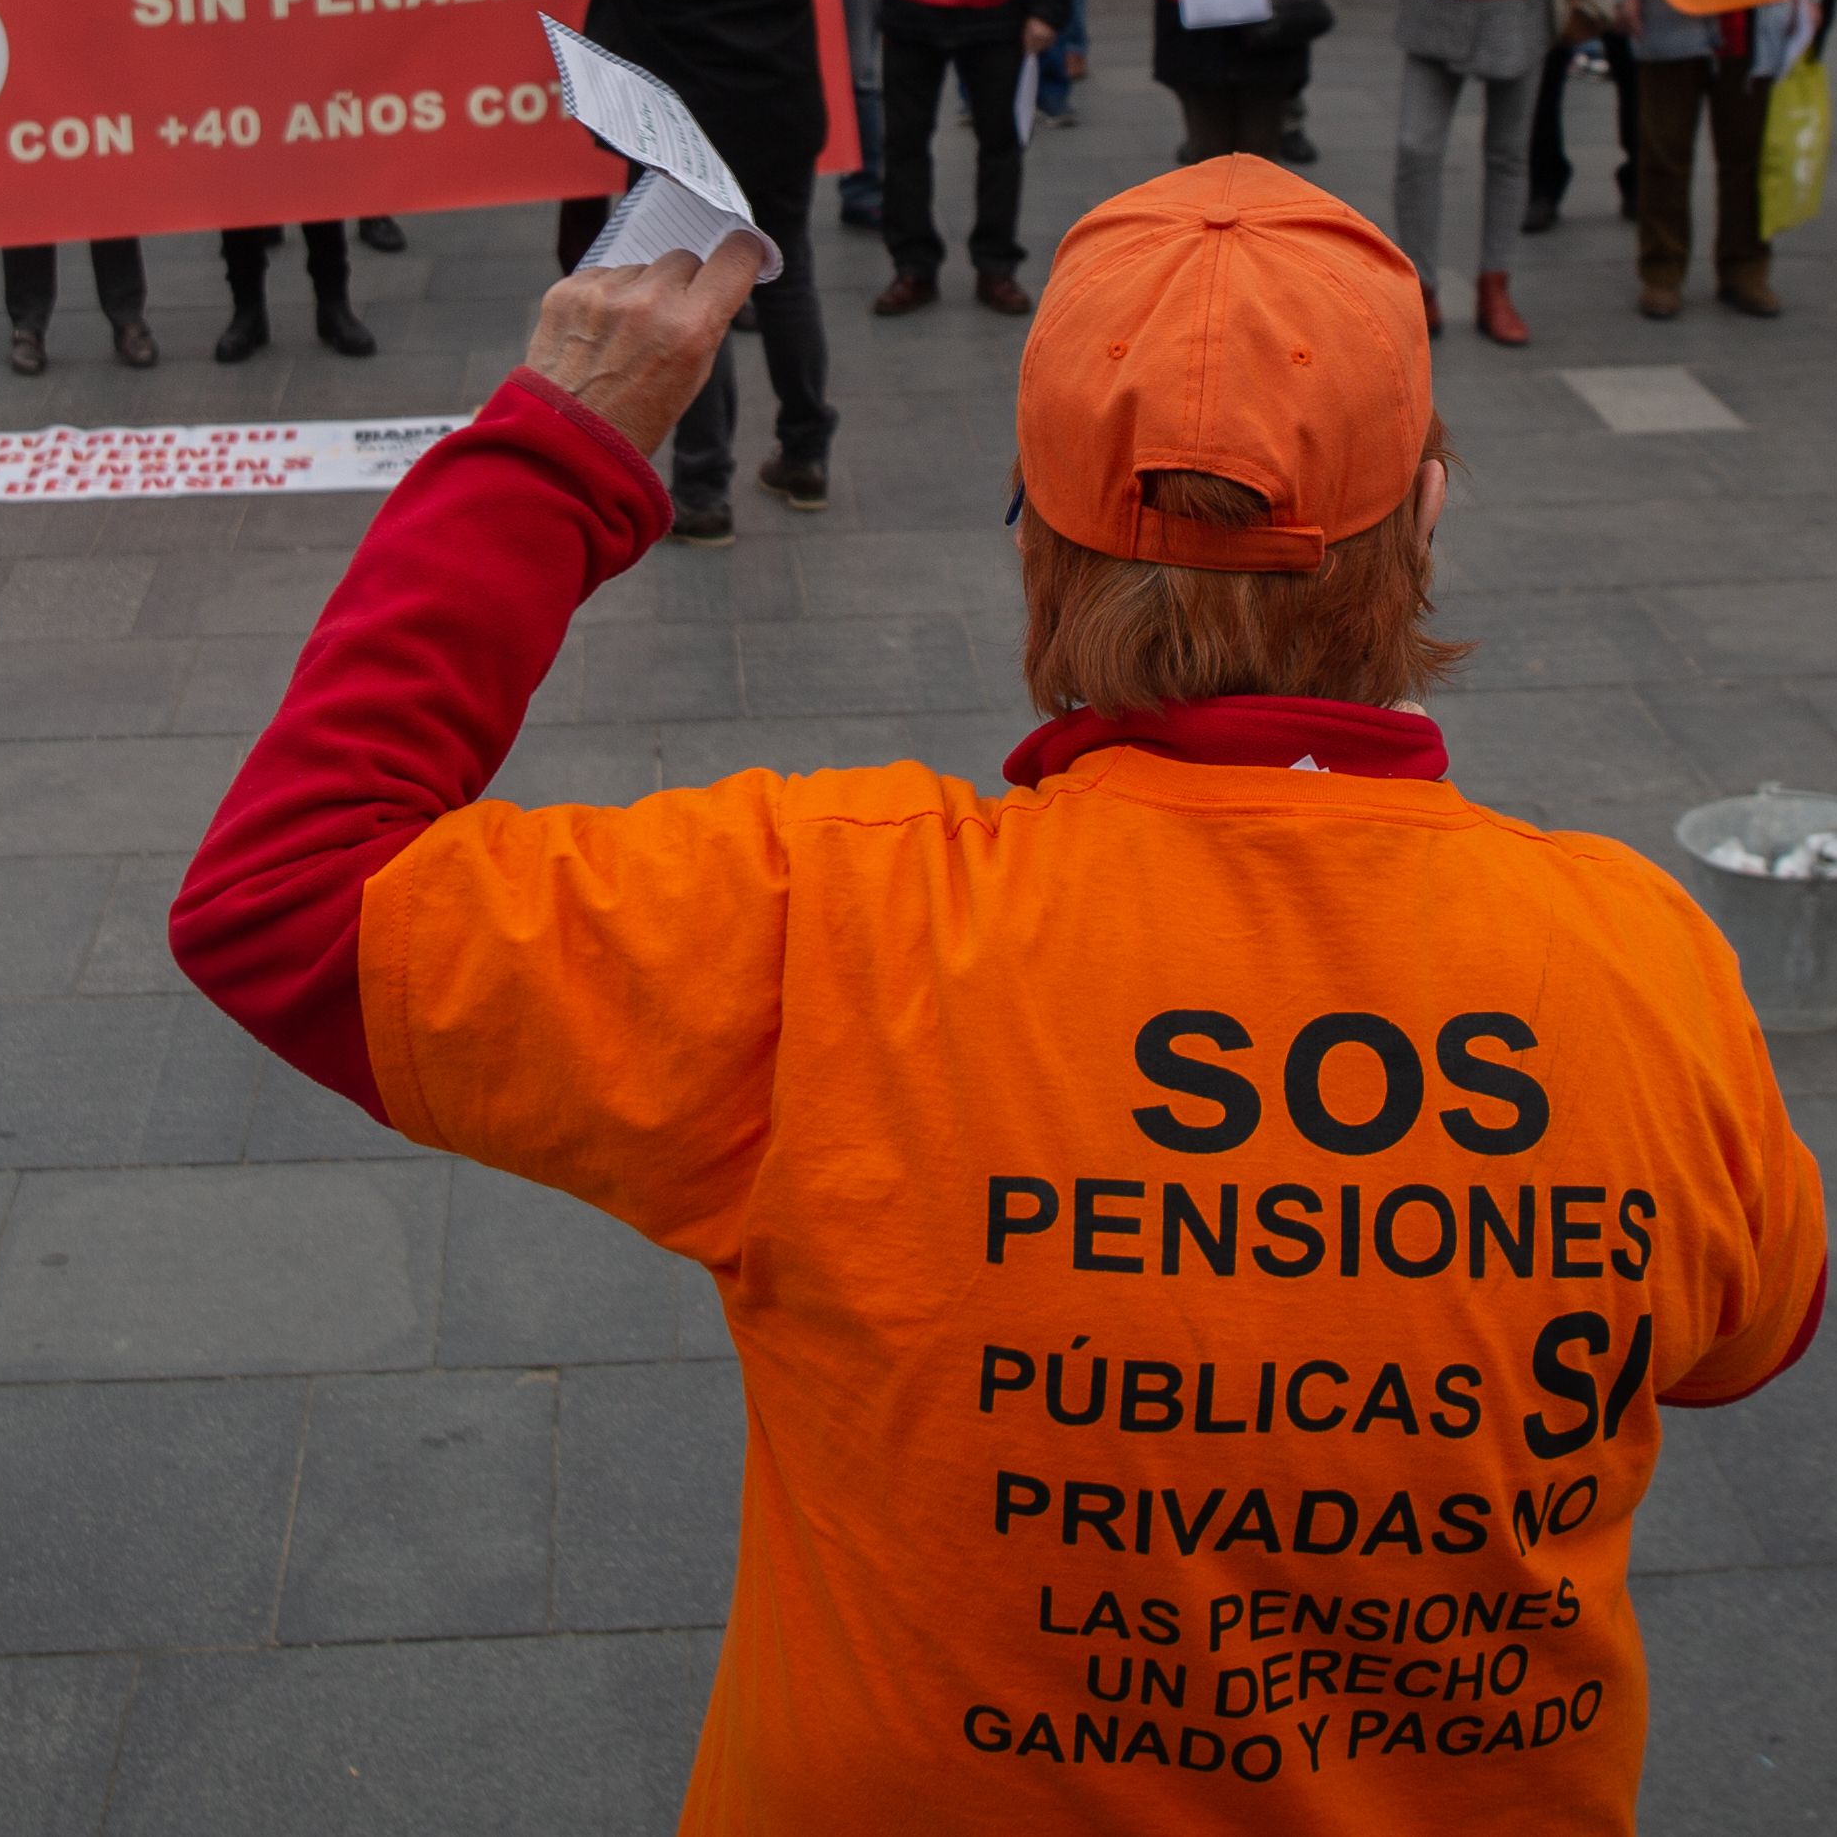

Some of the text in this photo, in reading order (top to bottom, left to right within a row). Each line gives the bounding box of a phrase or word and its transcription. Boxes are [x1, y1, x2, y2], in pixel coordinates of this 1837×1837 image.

[7, 114, 135, 163] CON
[158, 105, 262, 149] +40
[284, 90, 448, 144] AÑOS
[1131, 1008, 1551, 1156] SOS
[984, 1175, 1659, 1282] PENSIONES
[977, 1310, 1653, 1460] PÚBLICAS SI
[993, 1471, 1600, 1558] PRIVADAS NO
[1038, 1576, 1582, 1652] LAS PENSIONES
[1086, 1643, 1531, 1720] UN DERECHO
[963, 1679, 1604, 1784] GANADO Y PAGADO
